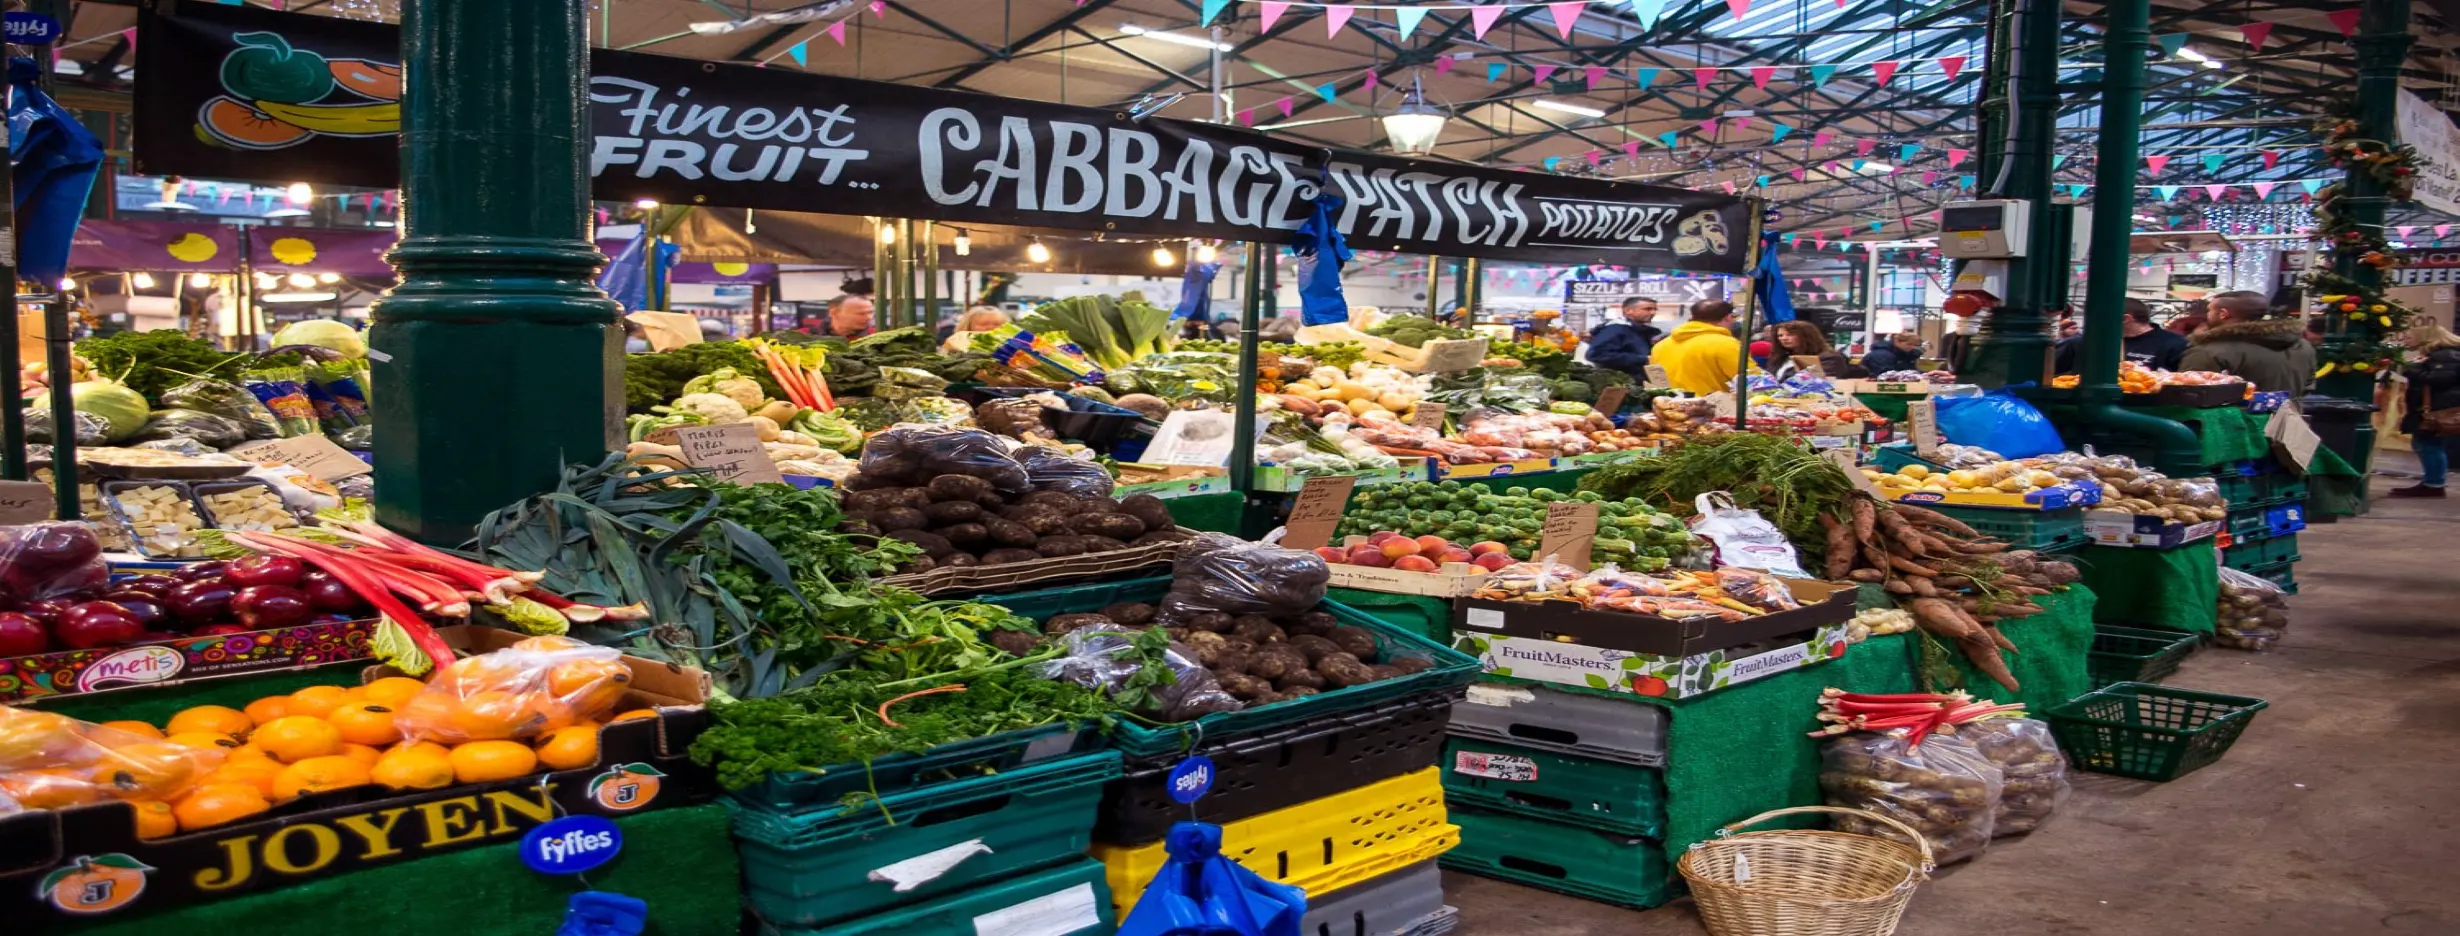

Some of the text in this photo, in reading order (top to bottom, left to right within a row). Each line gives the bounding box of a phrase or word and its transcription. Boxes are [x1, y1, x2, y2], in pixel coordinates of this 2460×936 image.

[3, 20, 48, 36] Fyffe
[590, 76, 856, 147] Finest
[918, 107, 1679, 248] CABBAGE PATCH POTATOES
[1573, 281, 1671, 294] SIZZLE & ROLL
[100, 654, 173, 677] metis
[1502, 646, 1616, 671] FruitMasters.
[194, 783, 559, 890] JOYEN
